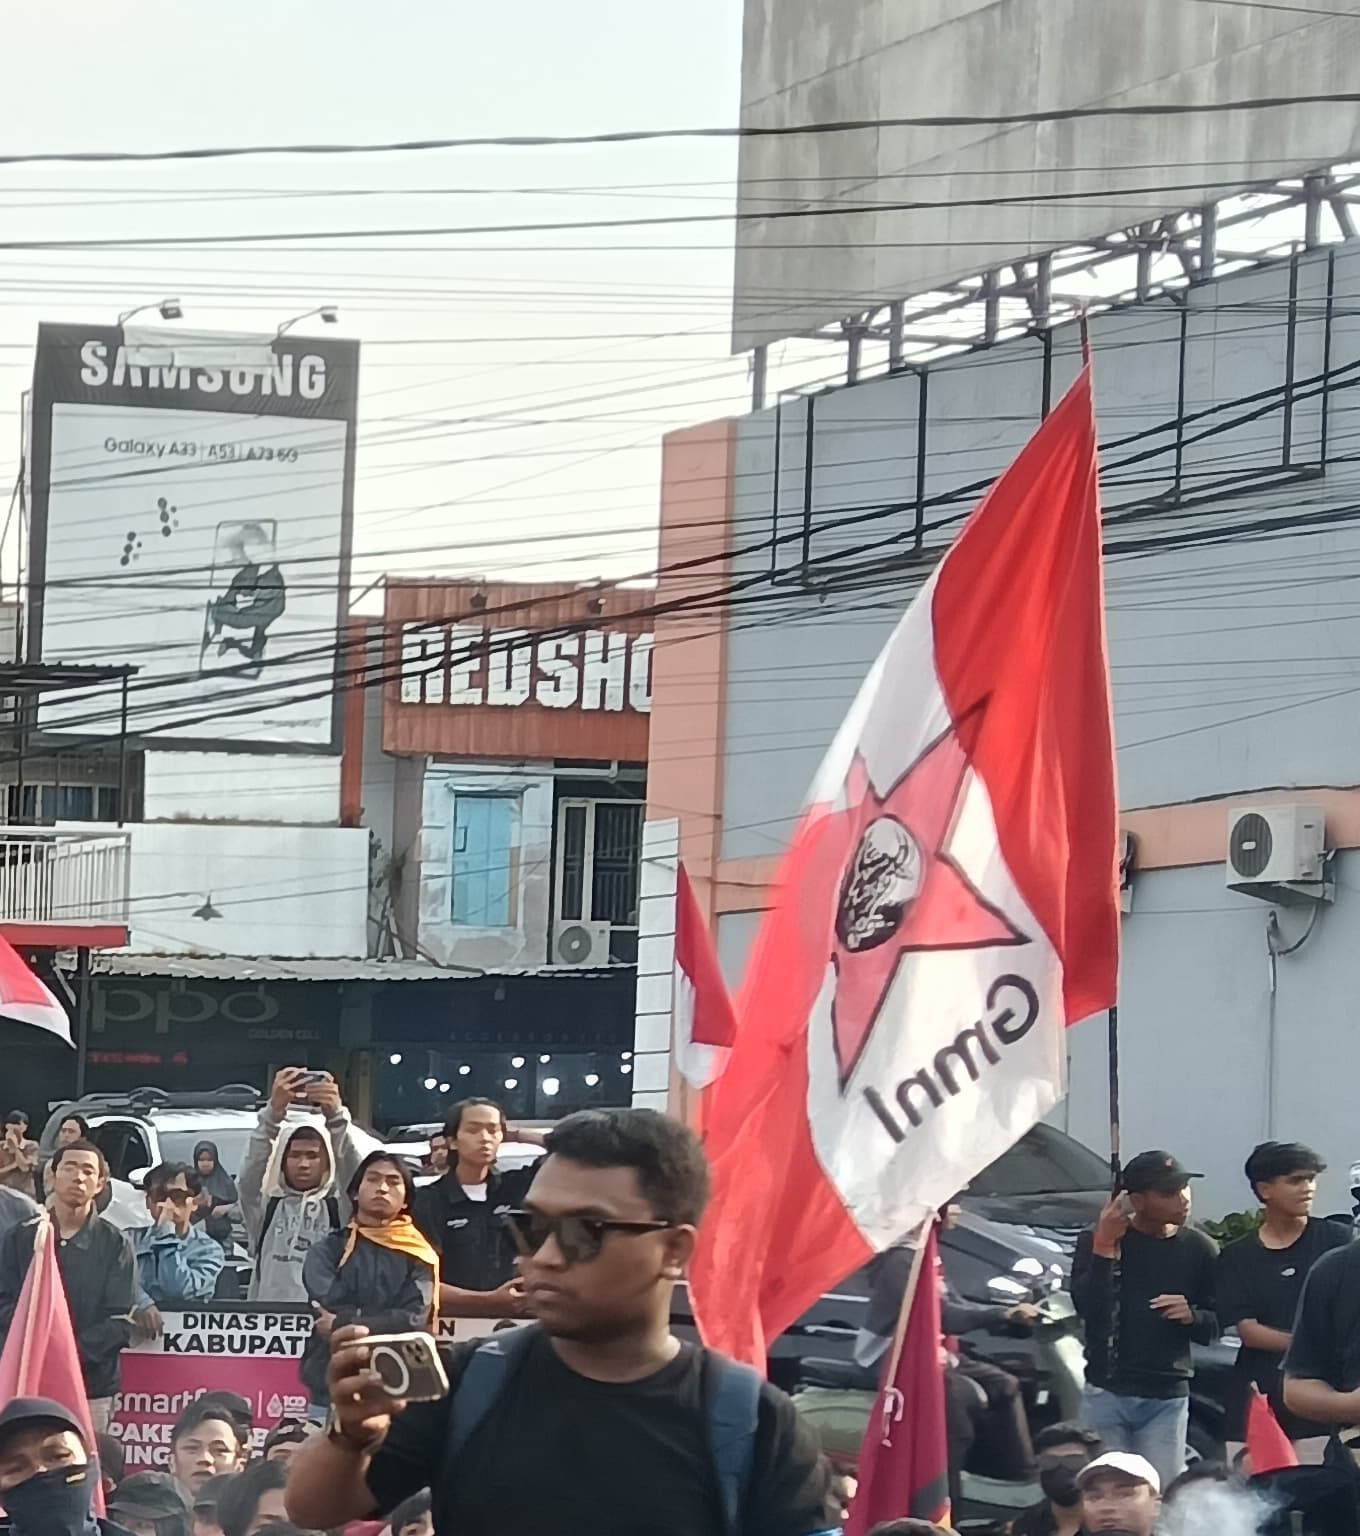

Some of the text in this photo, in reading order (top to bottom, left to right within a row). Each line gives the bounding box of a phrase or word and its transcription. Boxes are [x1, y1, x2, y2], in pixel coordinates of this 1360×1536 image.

[104, 437, 165, 457] Galaxy
[169, 441, 197, 456] A33
[182, 1312, 258, 1331] DINAS
[163, 1332, 311, 1356] KABUPAT
